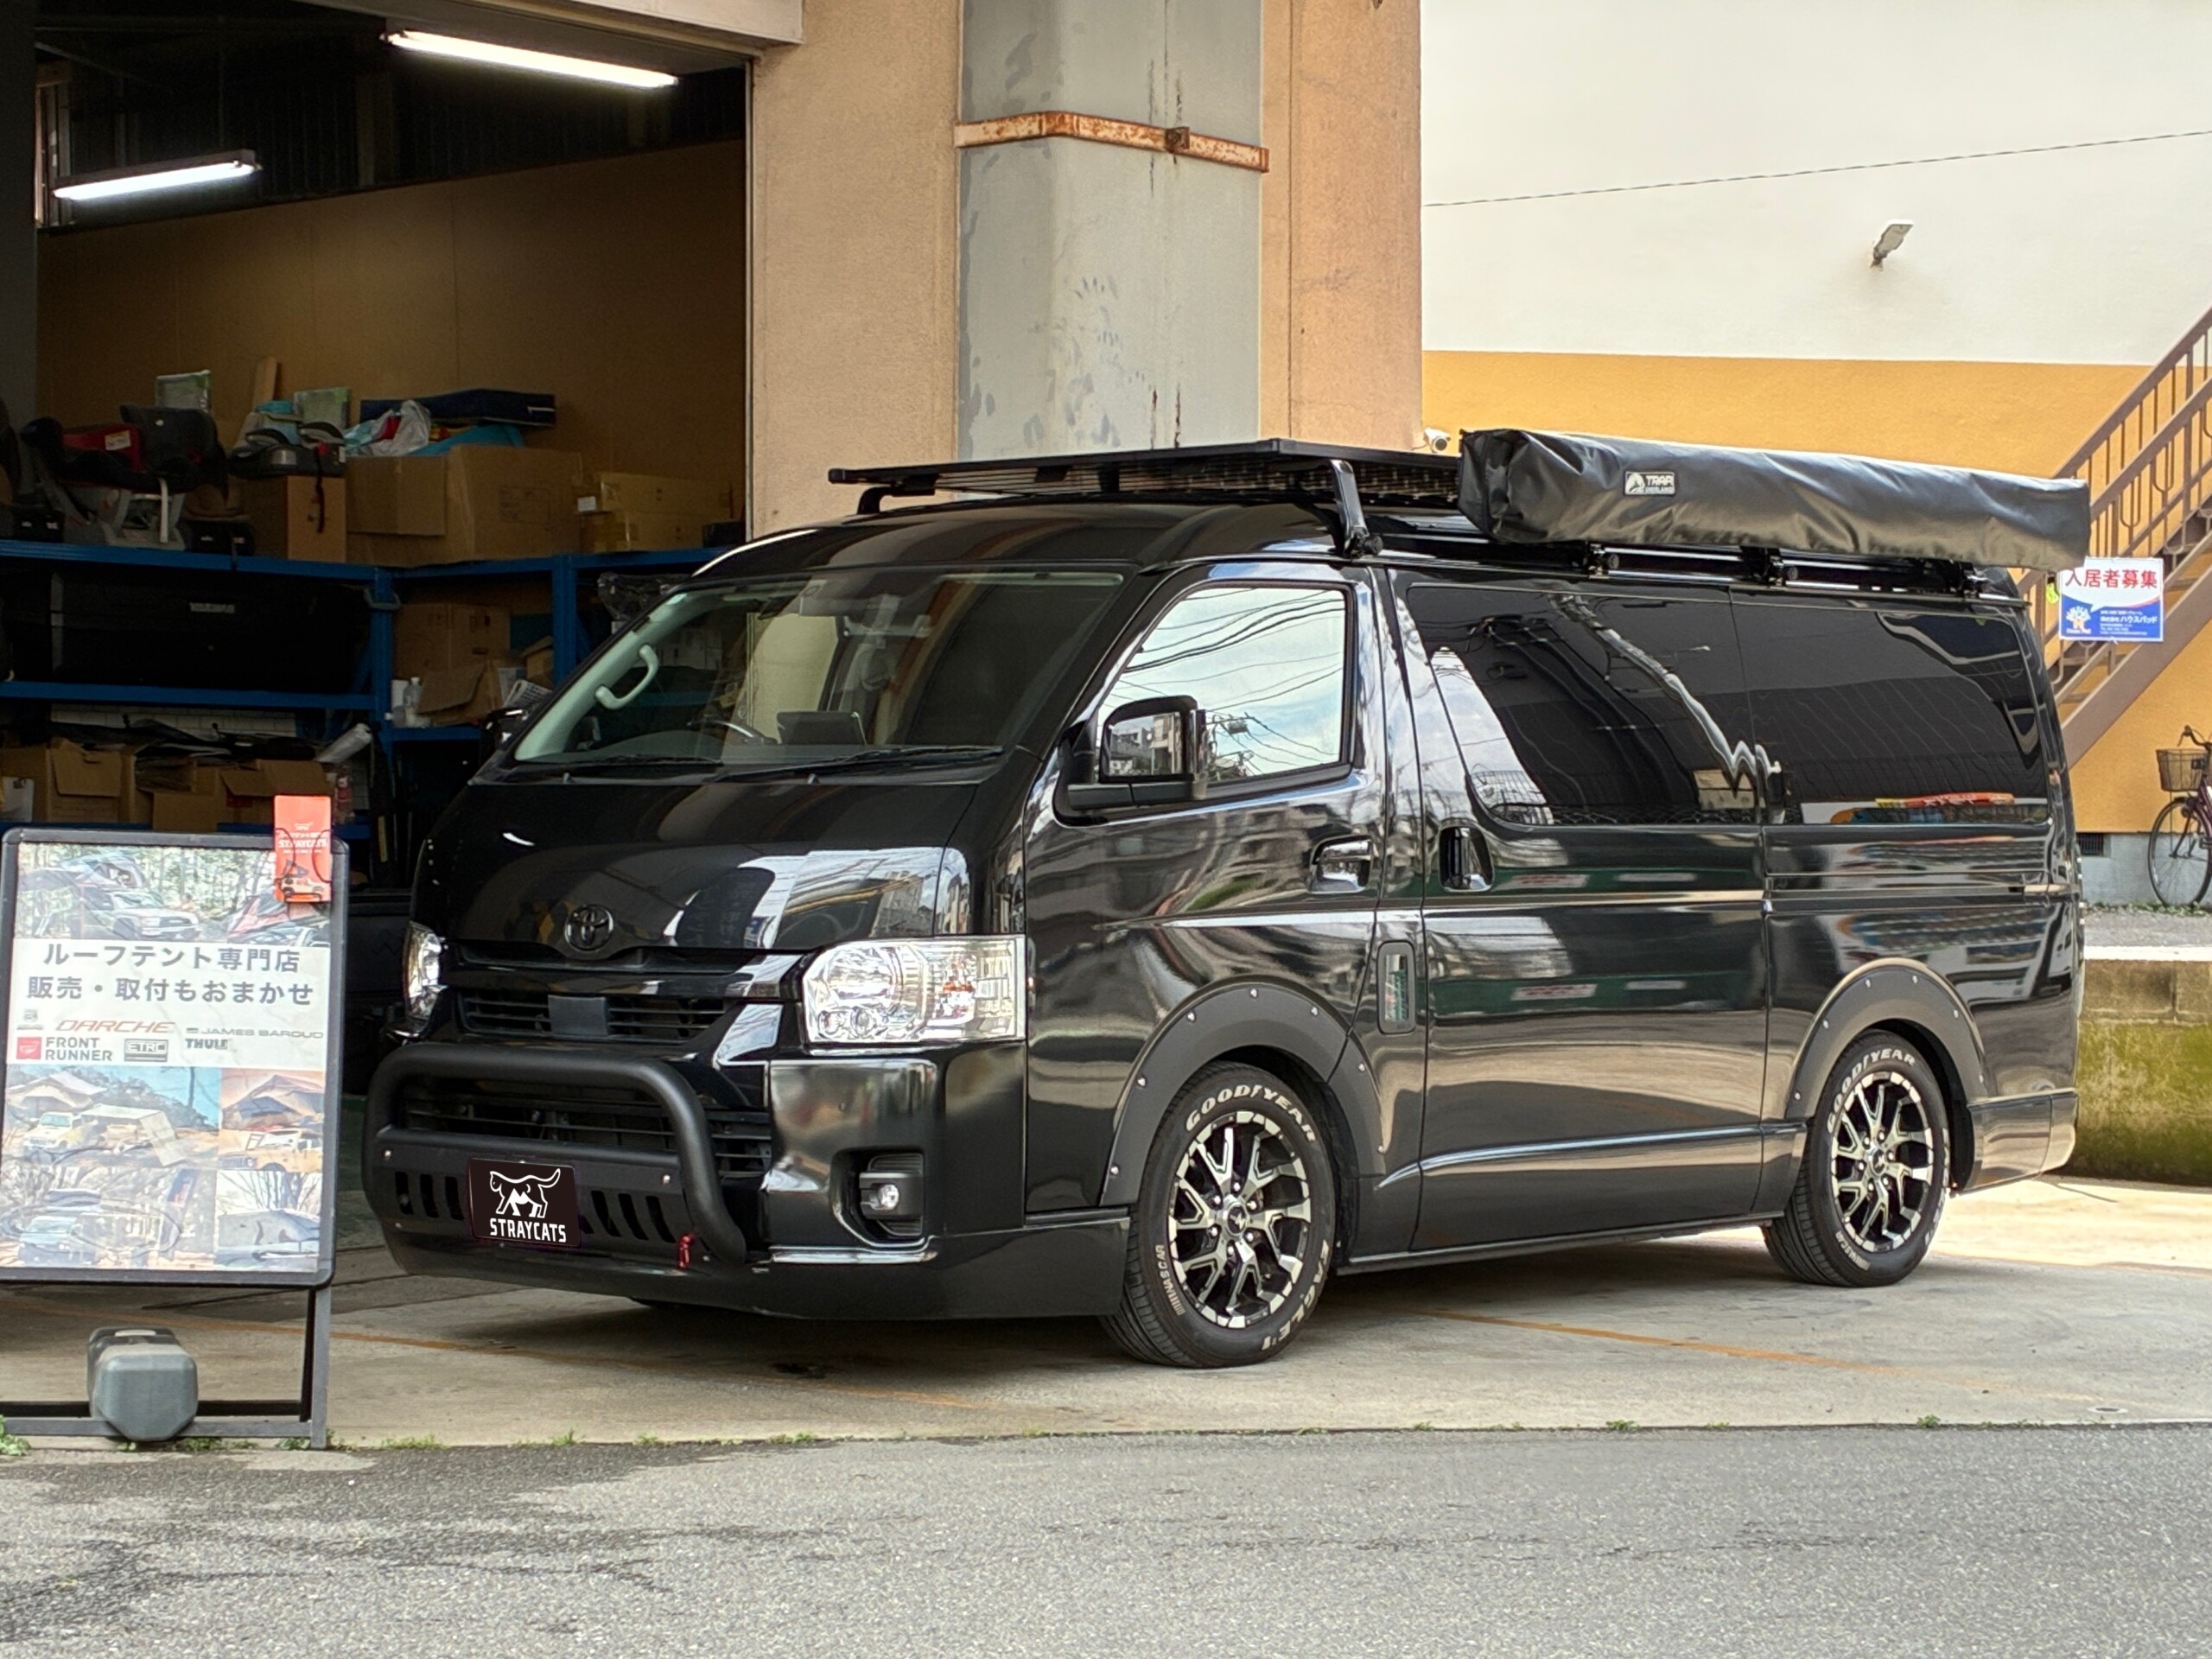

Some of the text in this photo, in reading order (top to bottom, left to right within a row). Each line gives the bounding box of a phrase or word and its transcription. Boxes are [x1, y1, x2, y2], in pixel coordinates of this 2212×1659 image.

[2065, 568, 2158, 589] 入居者募集
[43, 944, 300, 973] ルーフテント専門店
[27, 976, 314, 1006] 販売・取付もおまかせ
[55, 1020, 175, 1033] DARCHE
[258, 1029, 323, 1039] BAROUD
[45, 1037, 99, 1048] FRONT
[45, 1049, 113, 1062] RUNNER
[1827, 1048, 1916, 1134] GOODYEAR
[1186, 1084, 1316, 1142] GOODYEAR
[489, 1217, 567, 1243] STRAYCATS
[1155, 1245, 1177, 1294] NASCAR
